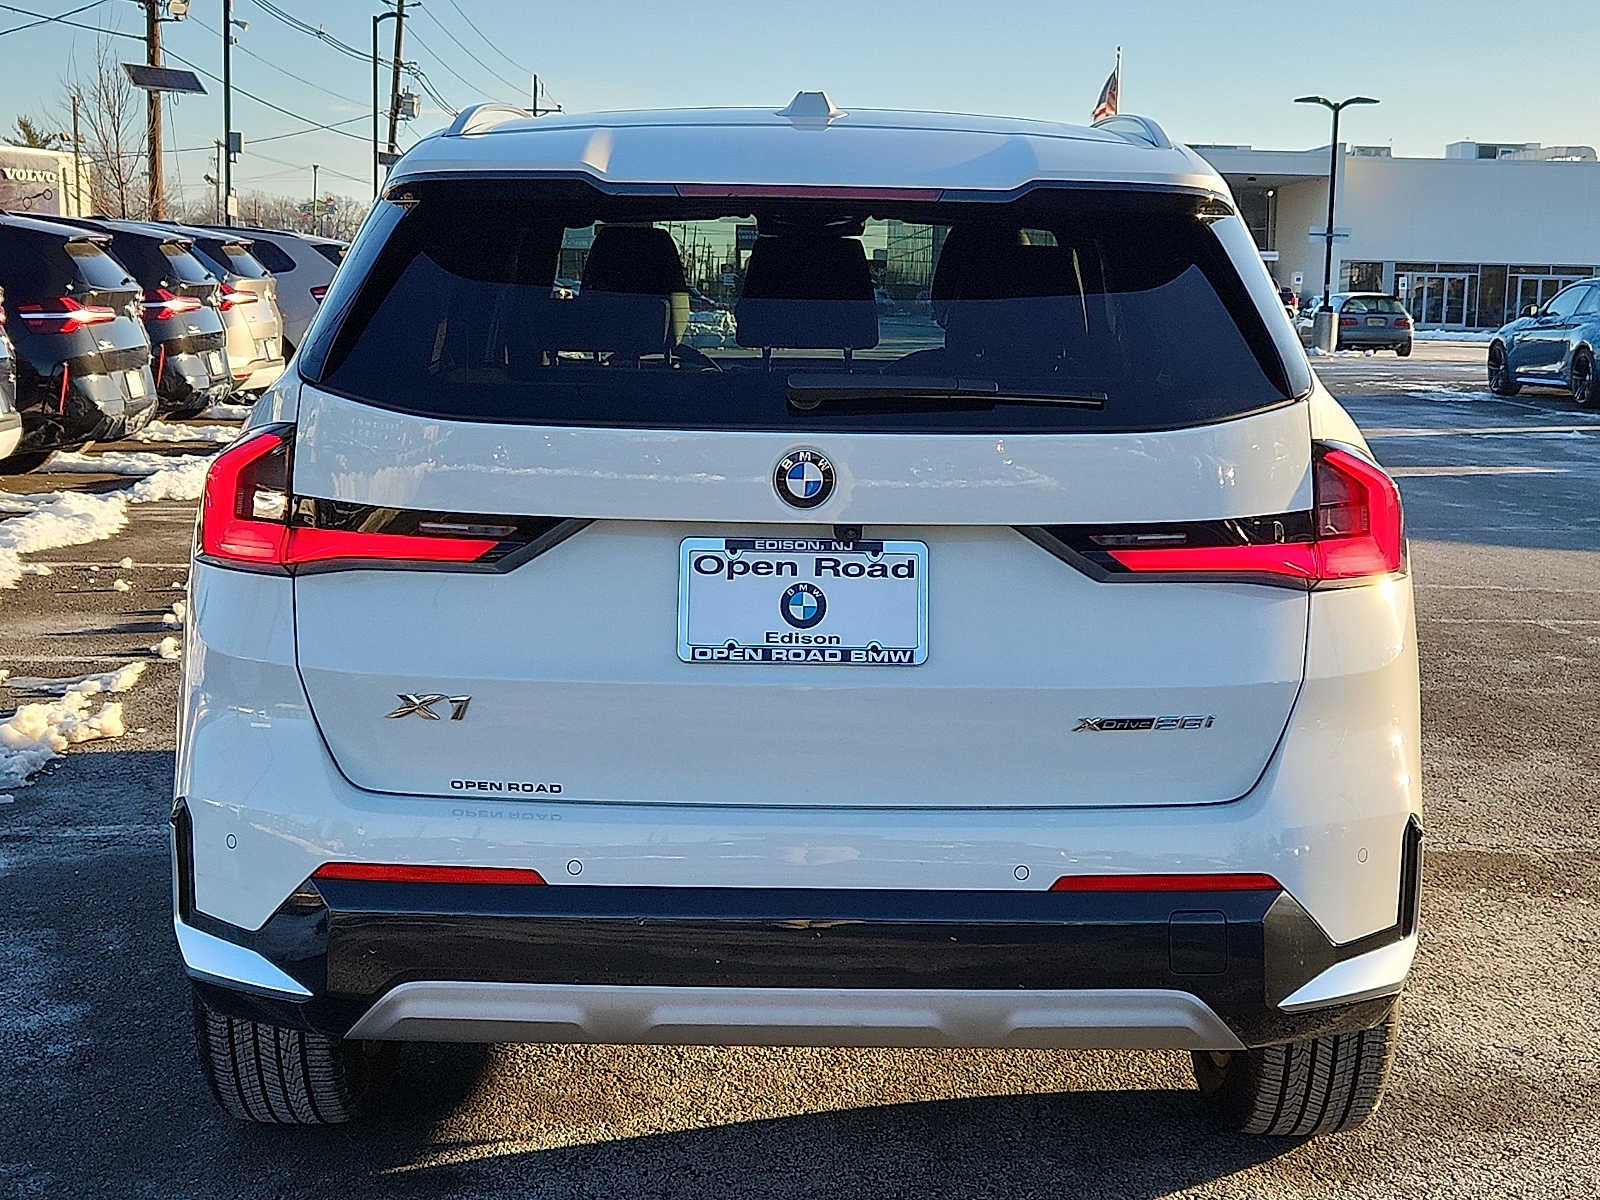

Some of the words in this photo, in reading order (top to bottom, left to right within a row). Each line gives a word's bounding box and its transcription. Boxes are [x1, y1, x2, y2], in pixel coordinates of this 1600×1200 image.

[4, 167, 58, 182] VOLVO
[781, 452, 830, 471] BMW
[755, 540, 825, 550] EDISON,
[831, 541, 853, 550] NJ
[693, 554, 798, 580] Open
[814, 557, 915, 578] Road
[787, 584, 822, 597] BMW
[765, 631, 840, 645] Edison
[694, 648, 762, 661] OPEN
[771, 649, 841, 662] ROAD
[850, 650, 911, 663] BMW
[384, 693, 472, 720] X1
[450, 780, 503, 791] OPEN
[507, 782, 562, 794] ROAD
